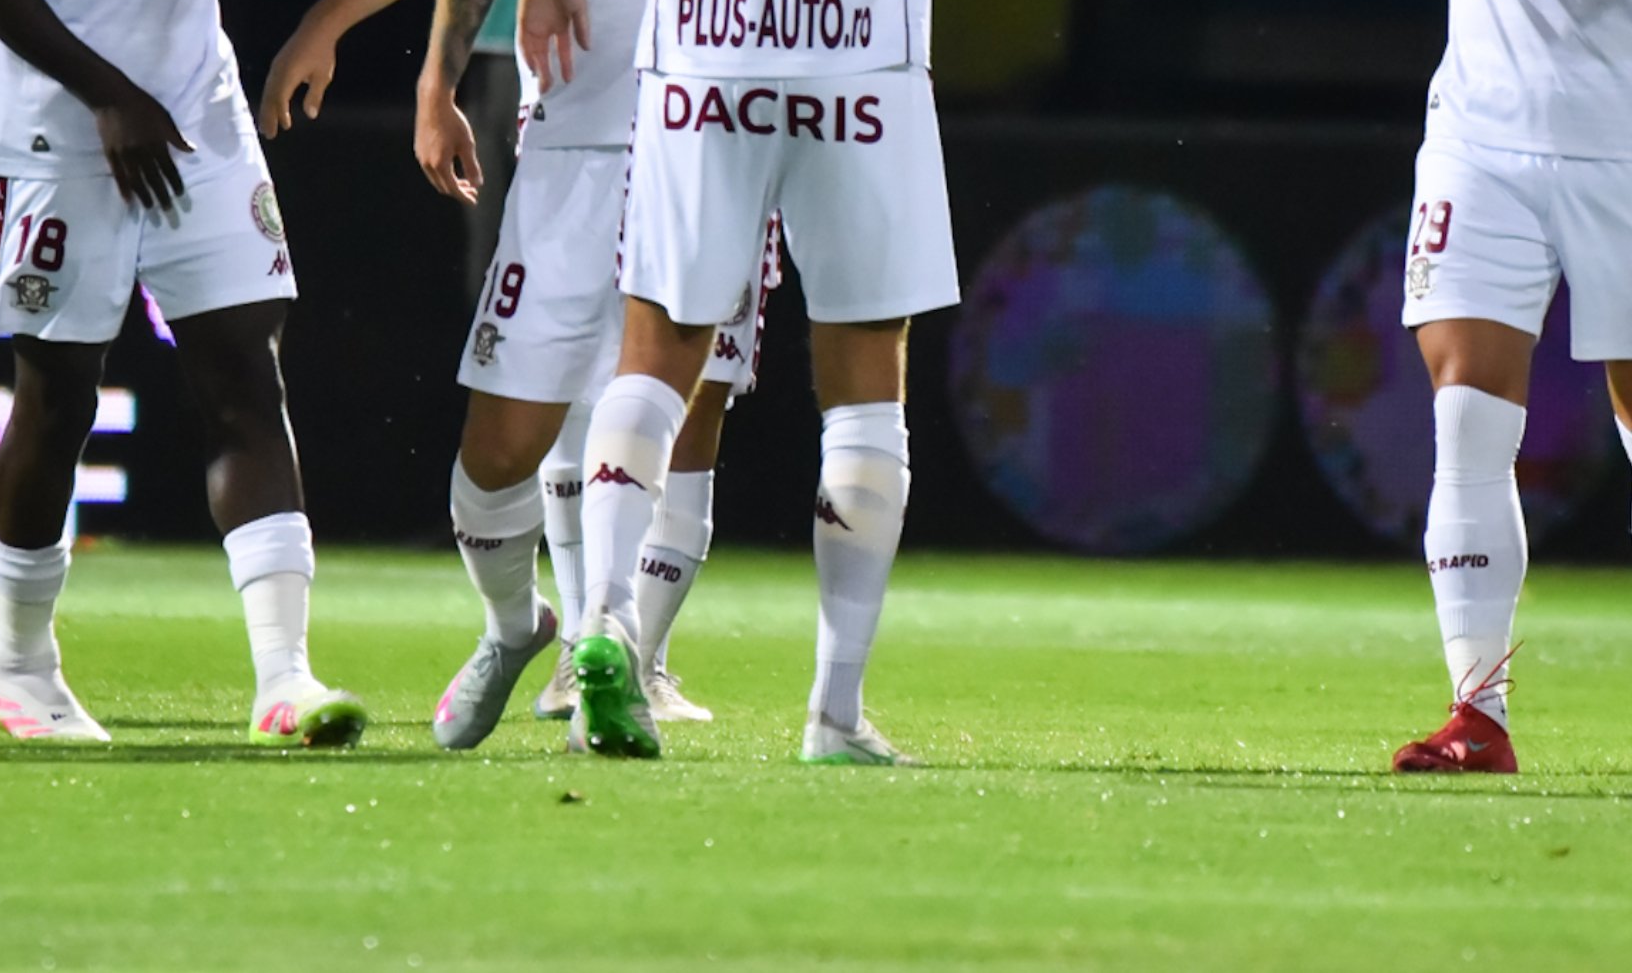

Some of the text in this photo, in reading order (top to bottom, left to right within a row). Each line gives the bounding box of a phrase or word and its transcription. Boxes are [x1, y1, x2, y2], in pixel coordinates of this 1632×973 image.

[664, 83, 884, 144] DACRIS
[15, 213, 68, 273] 18
[1439, 553, 1489, 570] RAPID
